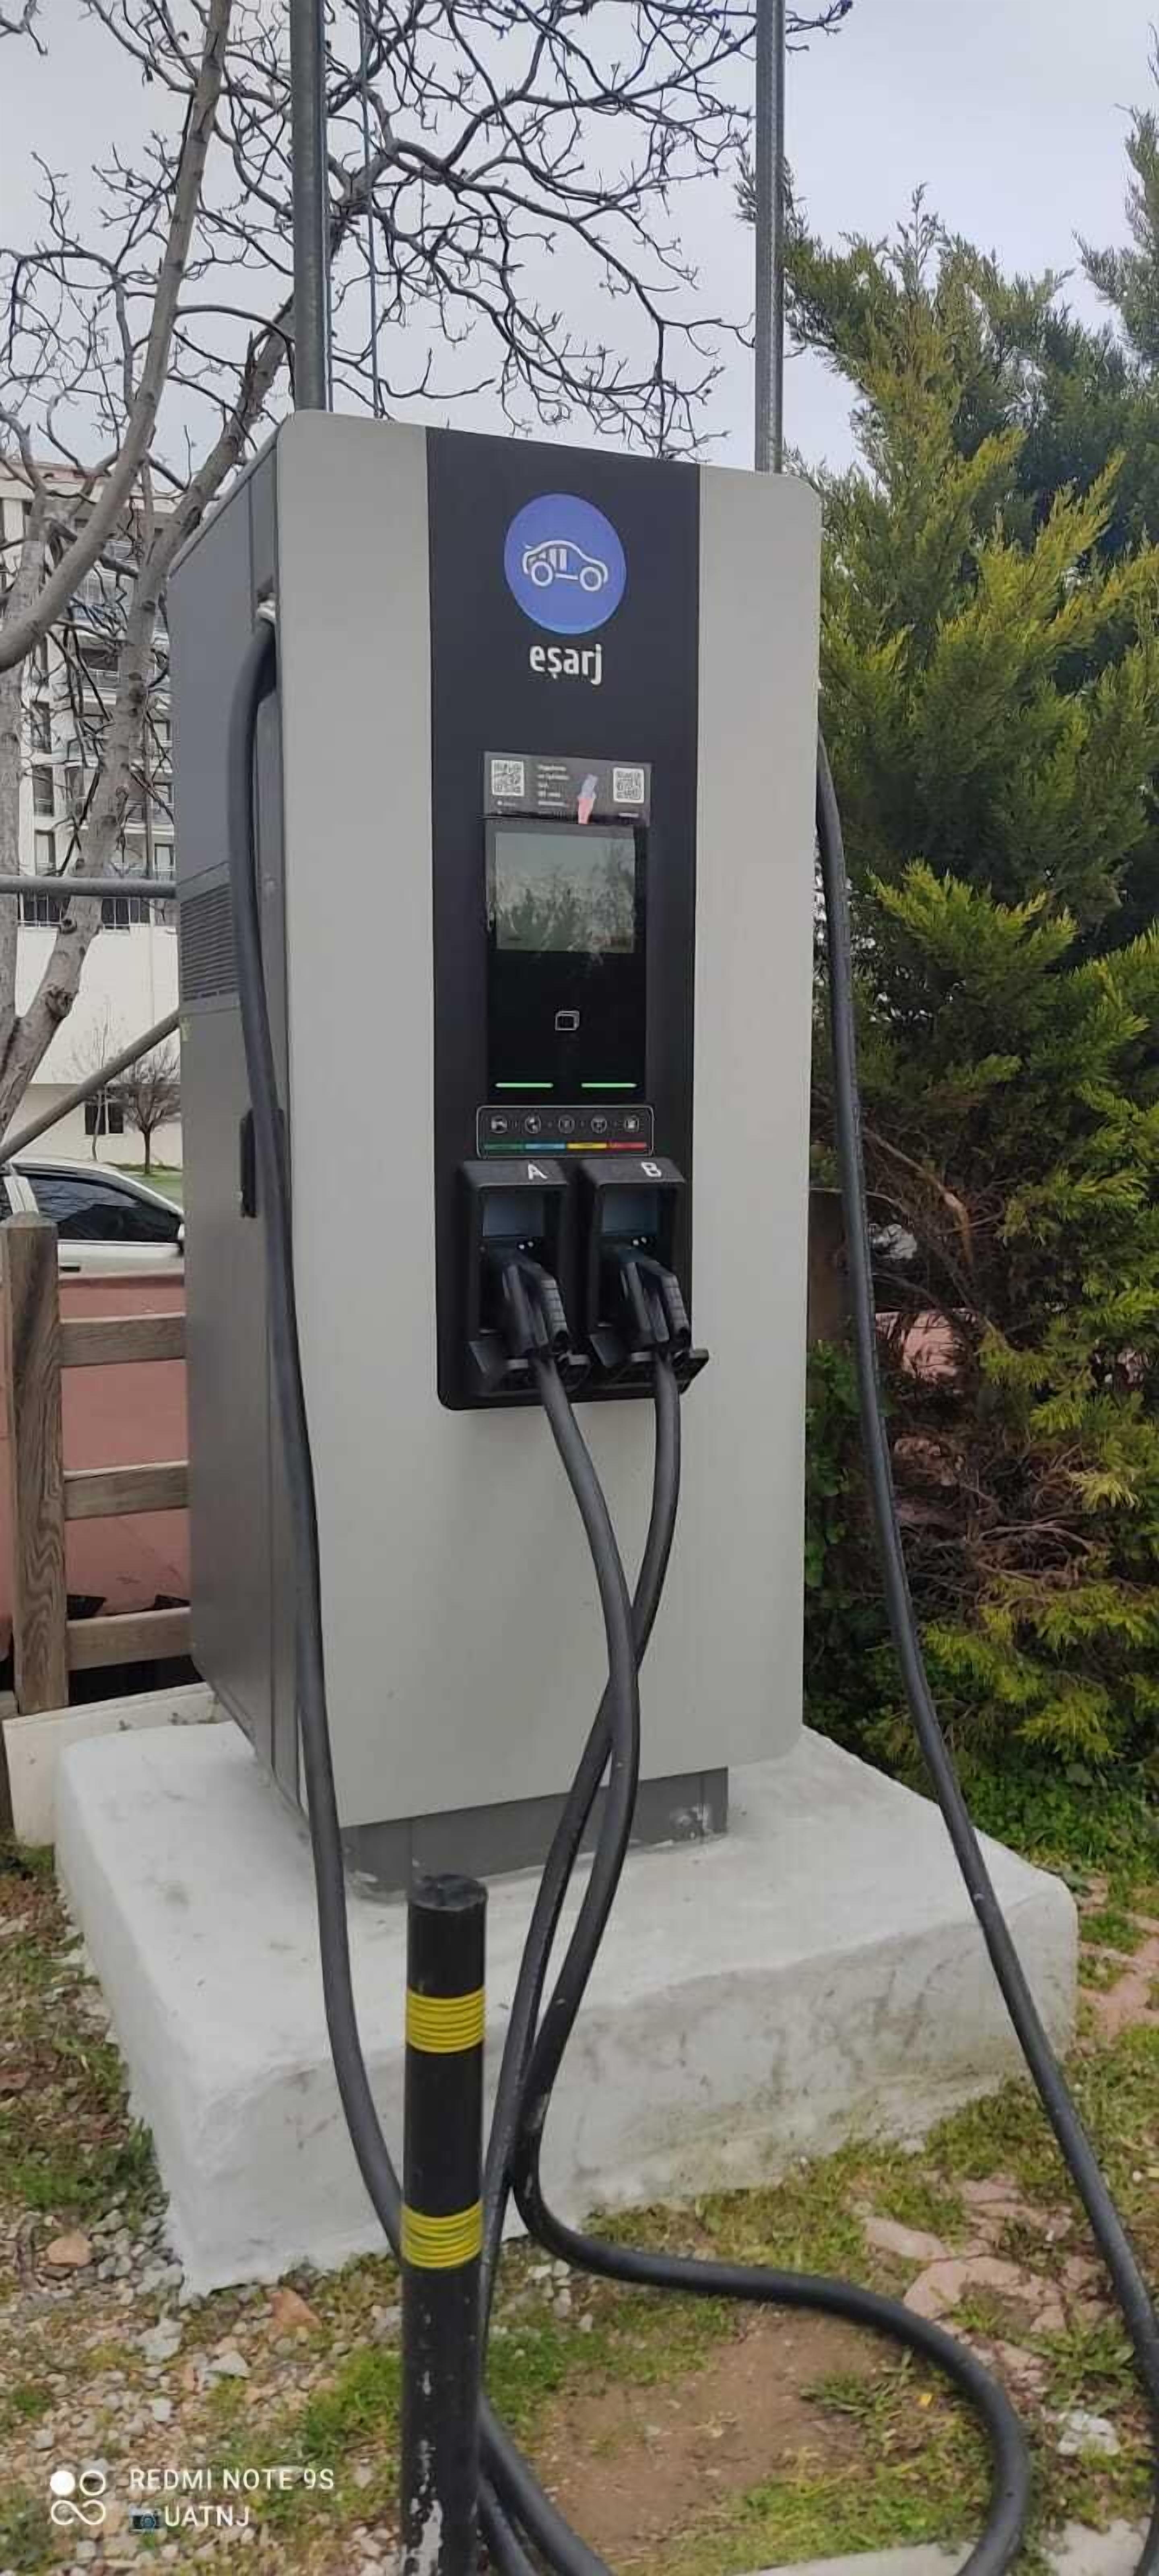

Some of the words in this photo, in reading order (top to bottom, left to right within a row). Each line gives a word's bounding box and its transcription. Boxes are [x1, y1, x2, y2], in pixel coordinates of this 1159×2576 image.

[530, 644, 602, 685] eşarj
[528, 1163, 547, 1180] A
[641, 1162, 662, 1177] B
